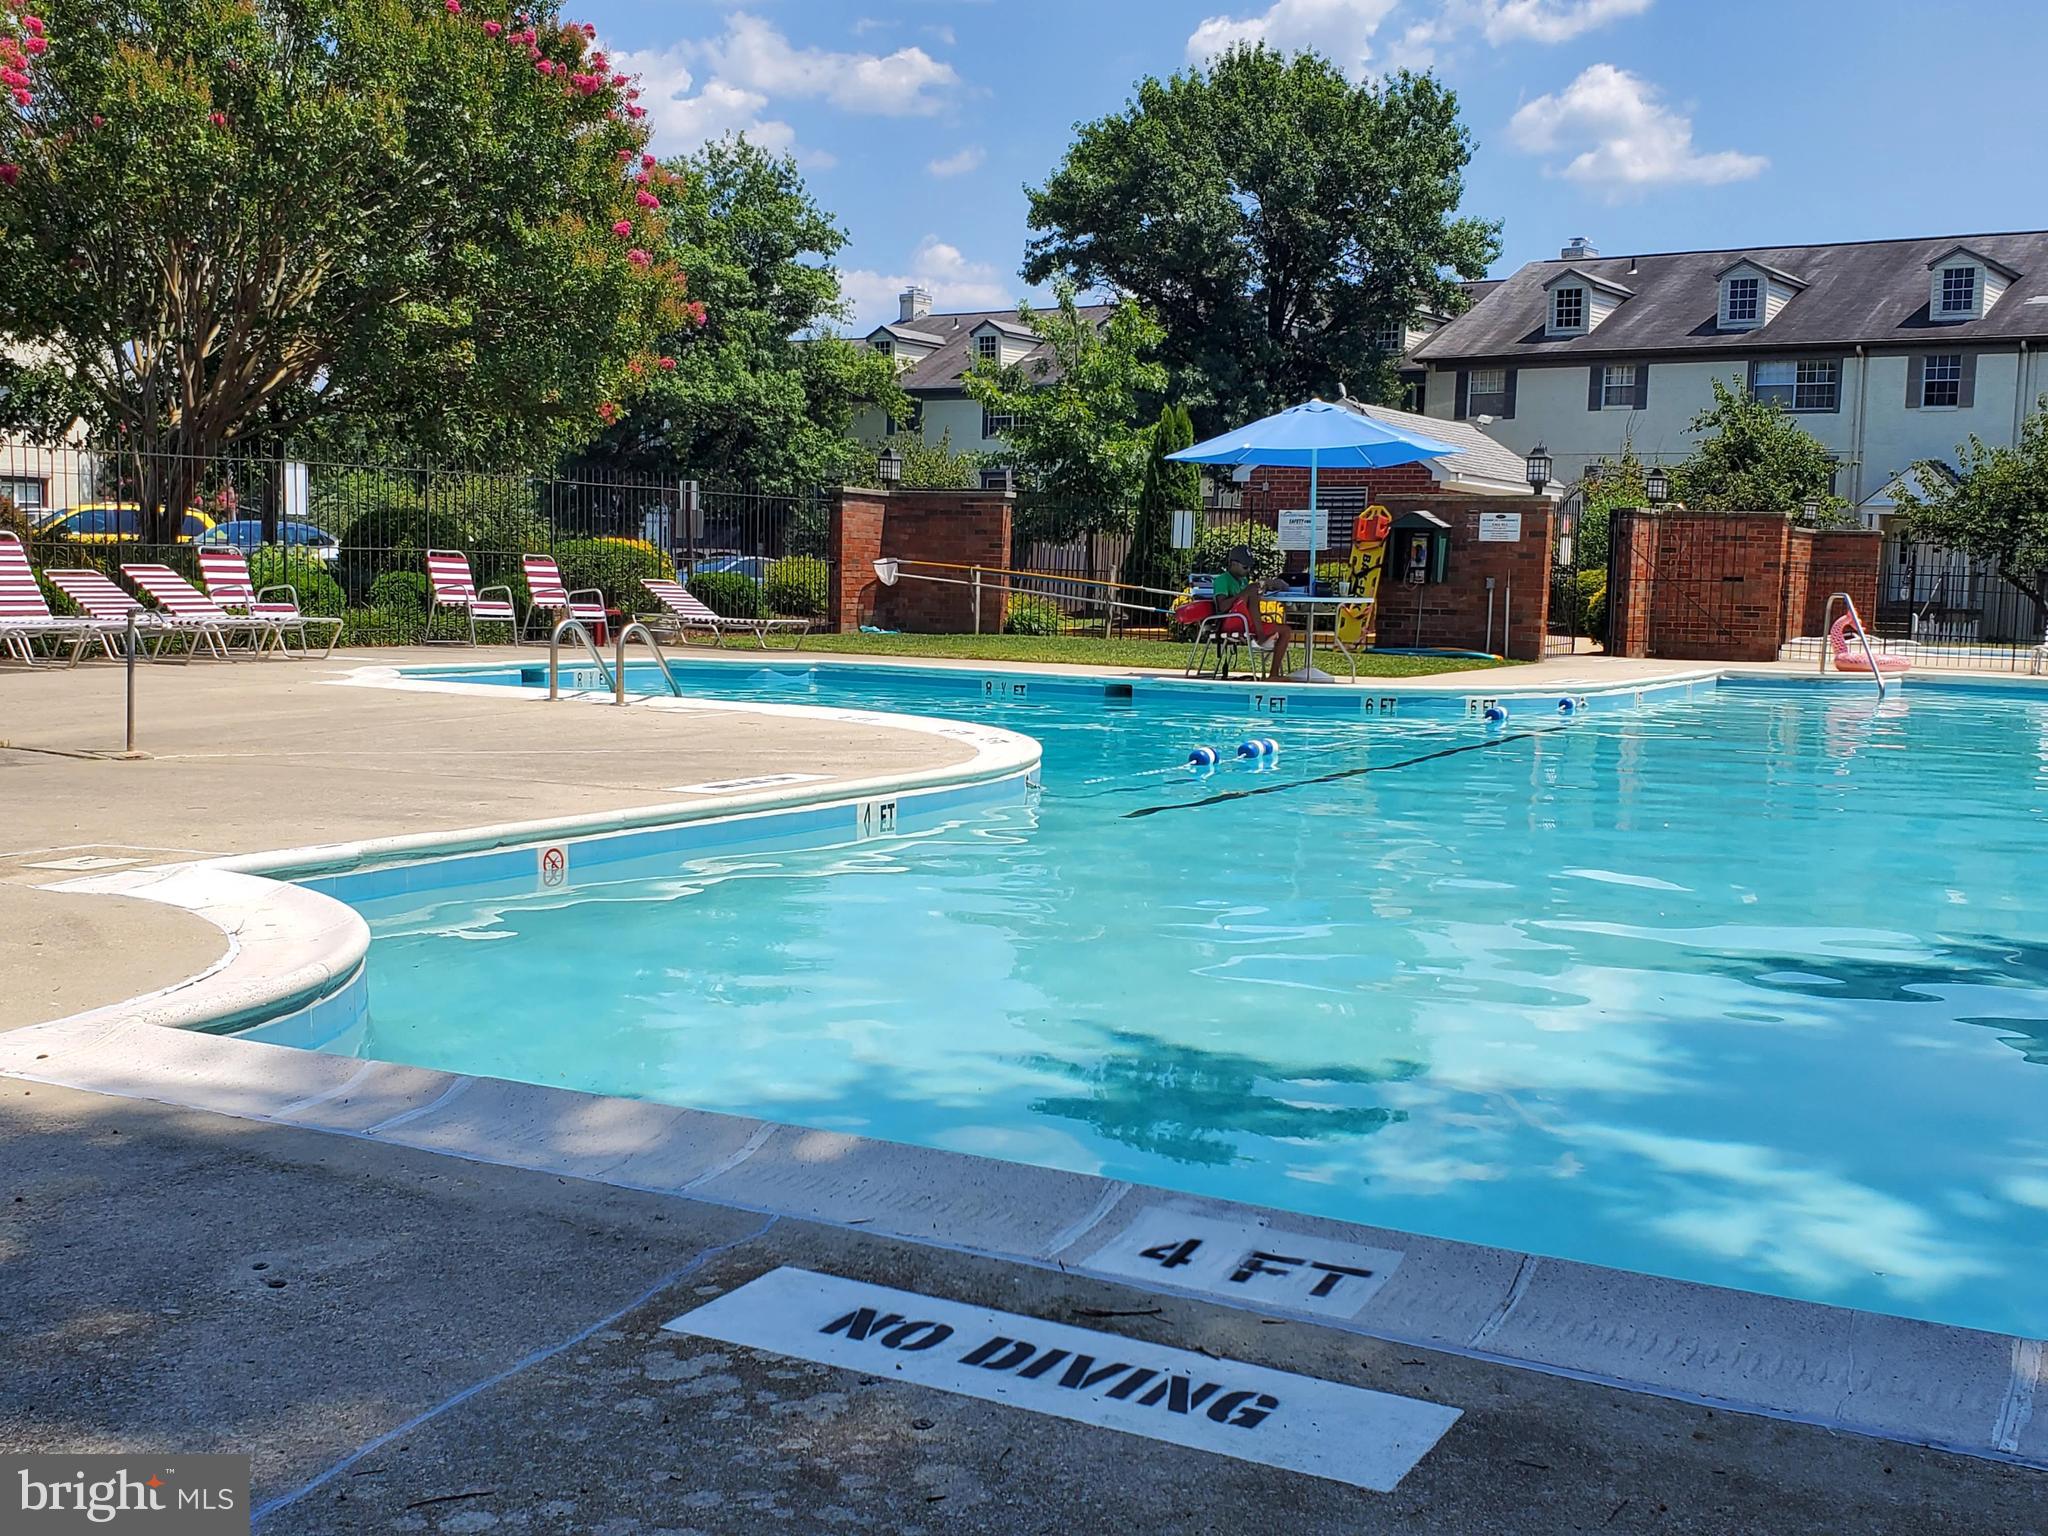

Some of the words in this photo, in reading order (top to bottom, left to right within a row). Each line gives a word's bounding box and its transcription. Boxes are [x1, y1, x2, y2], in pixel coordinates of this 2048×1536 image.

[1255, 696, 1263, 711] 7
[1365, 698, 1374, 714] 6
[1139, 1239, 1203, 1268] 4
[1228, 1251, 1374, 1298] FT
[819, 1307, 955, 1351] NO
[957, 1336, 1280, 1430] DIVING
